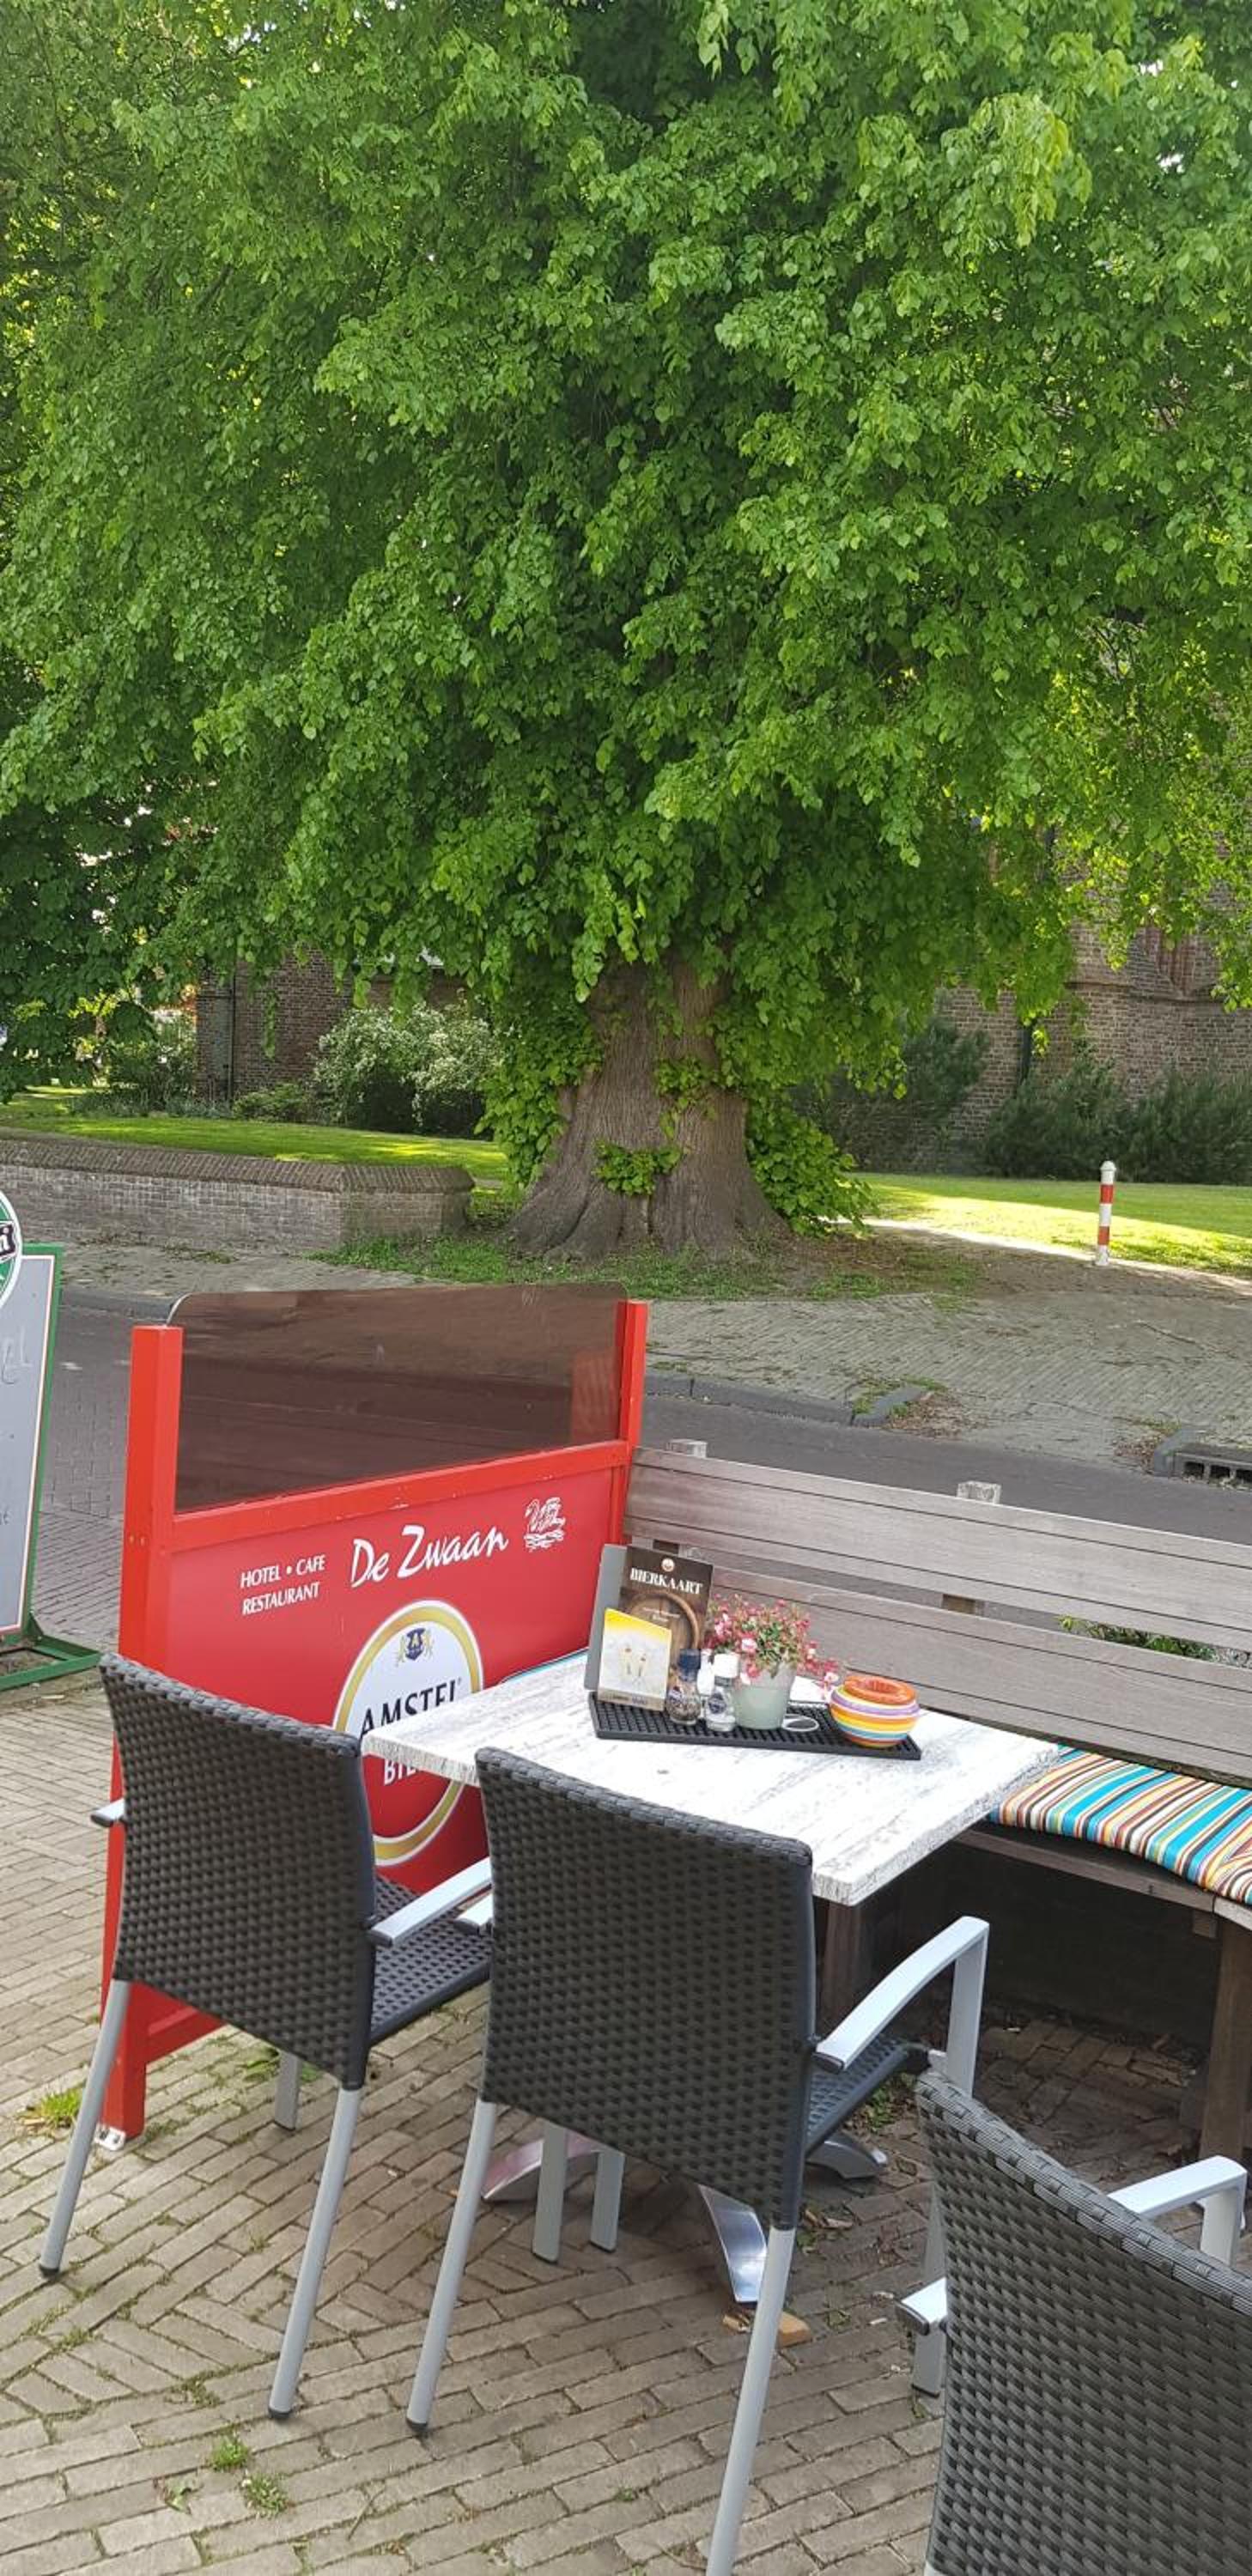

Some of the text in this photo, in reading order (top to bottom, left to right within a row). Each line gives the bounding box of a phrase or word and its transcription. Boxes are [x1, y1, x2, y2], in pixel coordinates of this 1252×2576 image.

[240, 1553, 327, 1589] HOTEL CAFE
[350, 1524, 509, 1588] De Zwaan
[629, 1567, 704, 1595] BIERKAART
[241, 1582, 321, 1615] RESTAURANT
[383, 1758, 417, 1784] BI
